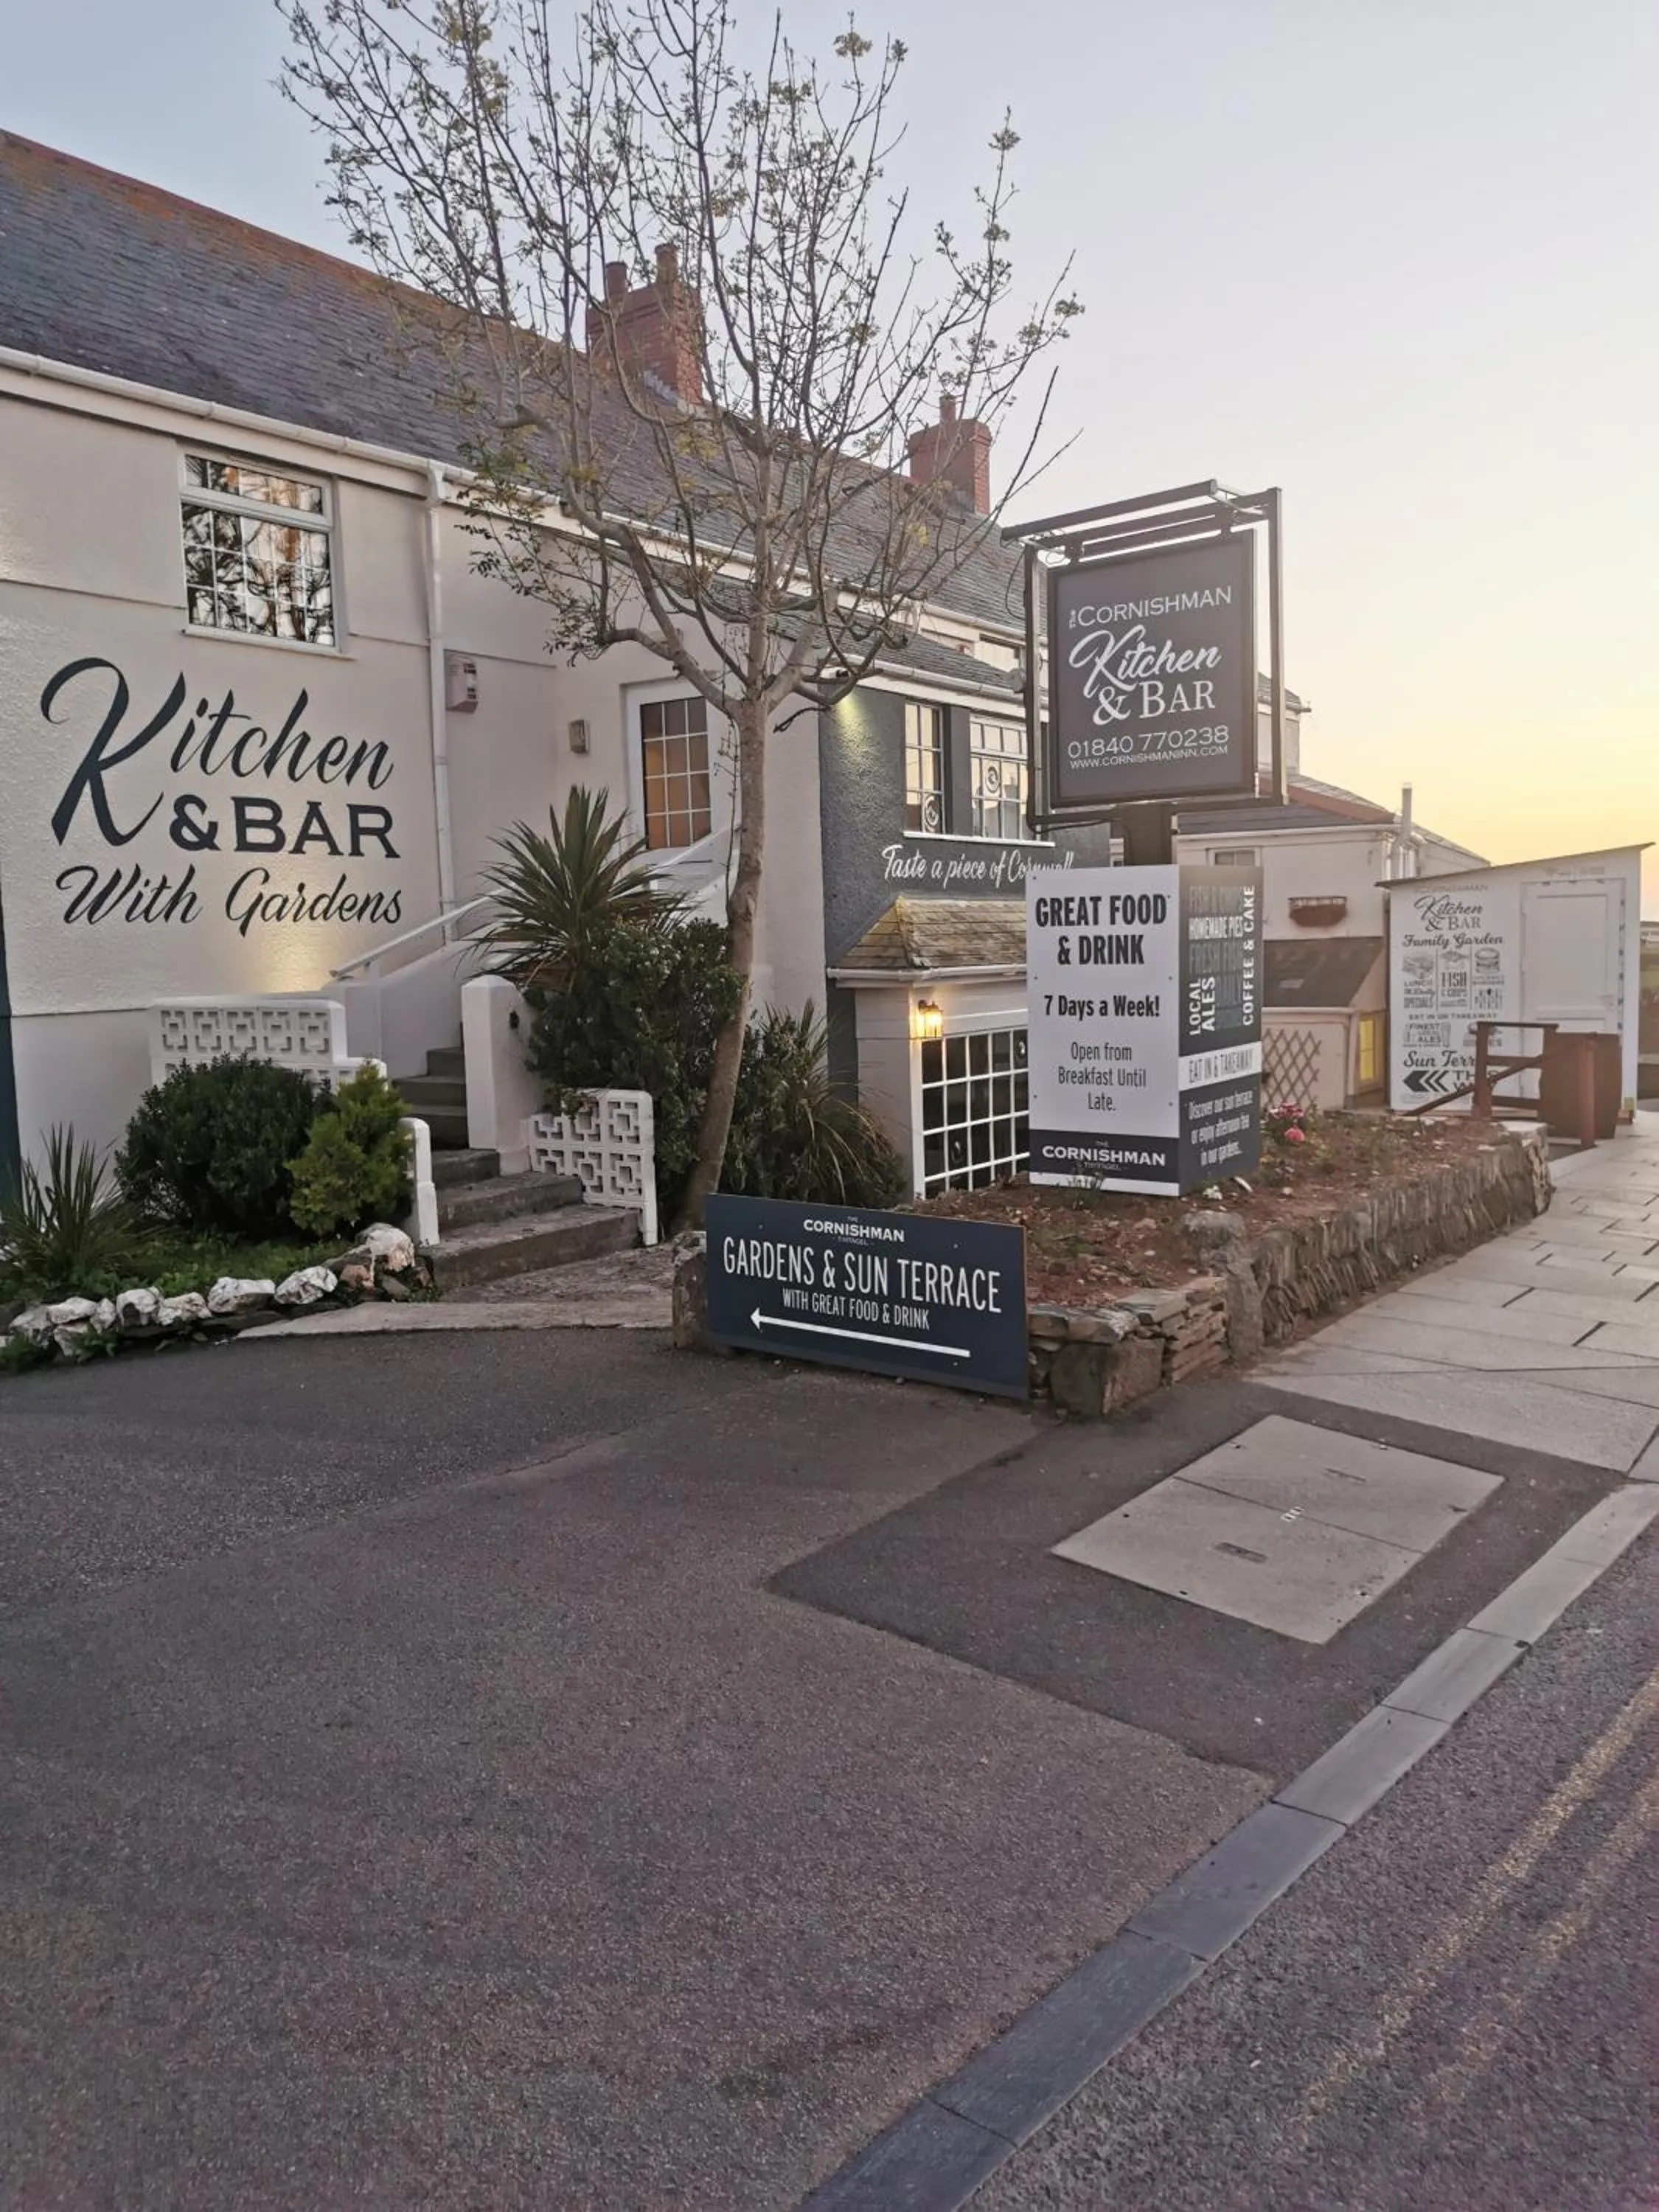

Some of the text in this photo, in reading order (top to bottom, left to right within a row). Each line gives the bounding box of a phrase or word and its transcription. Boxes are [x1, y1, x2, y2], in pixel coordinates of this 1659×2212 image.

[1077, 585, 1231, 626] CORNISHMAN
[1069, 625, 1222, 698] Kitchen
[1093, 680, 1217, 726] & BAR
[41, 657, 394, 846] Kitchen
[1068, 725, 1229, 759] 01840 770238
[882, 844, 927, 880] Taste
[931, 859, 943, 880] a
[942, 852, 986, 889] piece
[990, 850, 1007, 888] of
[55, 863, 402, 938] With Gardens
[1034, 894, 1167, 928] GREAT FOOD
[1243, 886, 1254, 933] CAKE
[1413, 894, 1484, 921] Kitchen
[1447, 915, 1481, 931] BAR
[1057, 934, 1145, 965] & DRINK
[1402, 932, 1503, 950] Family Garden
[1242, 939, 1254, 1026] COFFEE &
[1043, 995, 1160, 1020] 7 Days a Week!
[1189, 978, 1201, 1036] LOCAL
[1201, 976, 1216, 1032] ALES
[1071, 1041, 1132, 1064] Open from
[1403, 1049, 1475, 1067] Sun Terr
[1058, 1065, 1147, 1088] Breakfast Until
[1087, 1091, 1117, 1112] Late.
[1042, 1145, 1166, 1167] CORNISHMAN
[803, 1219, 905, 1242] CORNISHMAN
[723, 1236, 1002, 1313] GARDENS & SUN TERRACE
[782, 1288, 931, 1331] WITH GREAT FOOD & DRINK
